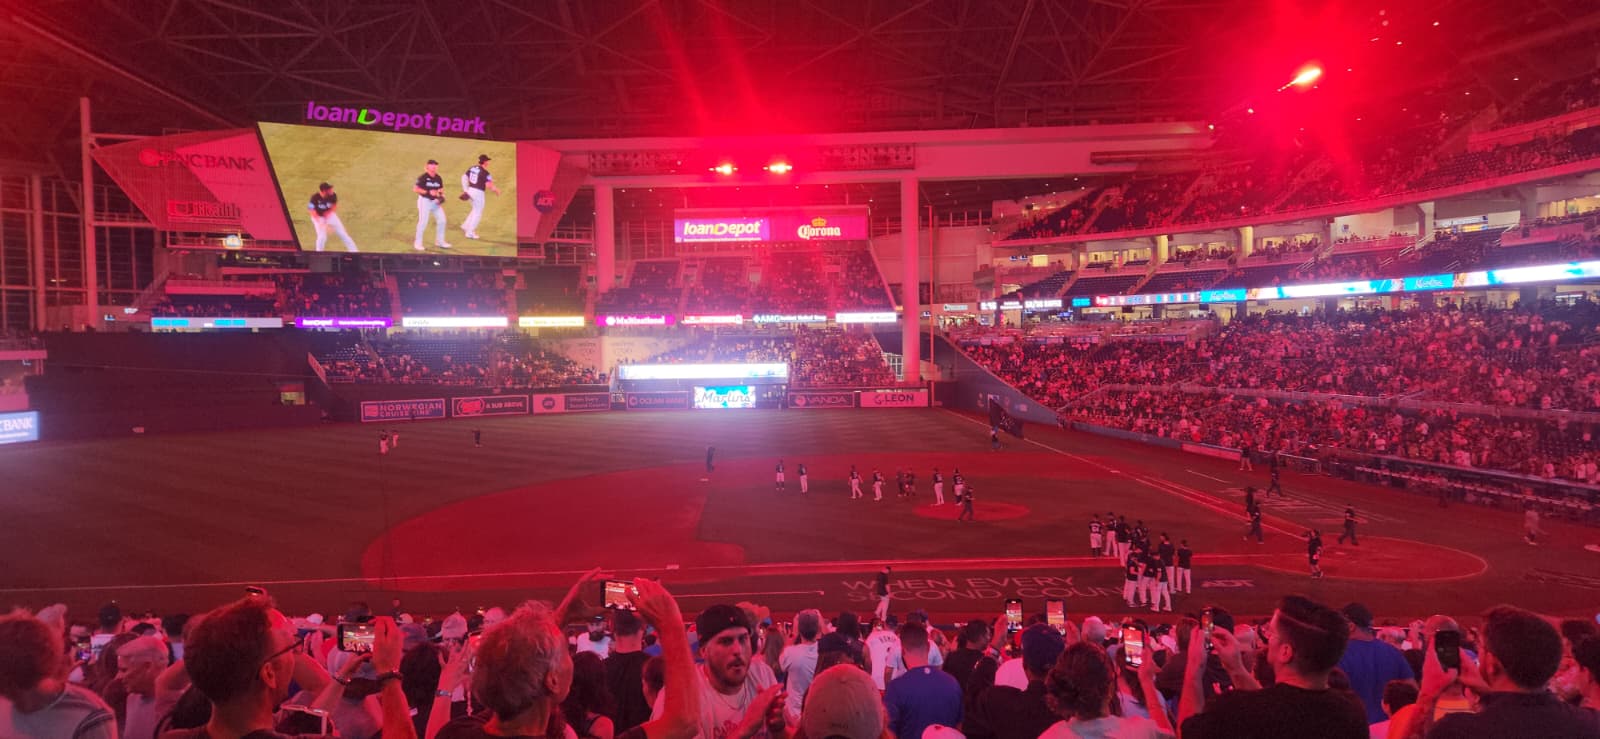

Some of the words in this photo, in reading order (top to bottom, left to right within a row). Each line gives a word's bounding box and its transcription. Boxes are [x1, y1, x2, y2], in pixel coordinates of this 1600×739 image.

[306, 101, 434, 131] loanDepot
[436, 115, 487, 134] park
[205, 154, 256, 171] BANK
[683, 221, 762, 237] loanDepot
[797, 224, 841, 240] Corona
[701, 391, 752, 404] Marlins
[885, 394, 914, 403] LEON
[379, 402, 443, 412] NORWEGIAN
[966, 576, 1075, 588] EVERY
[1016, 586, 1125, 599] COUN
